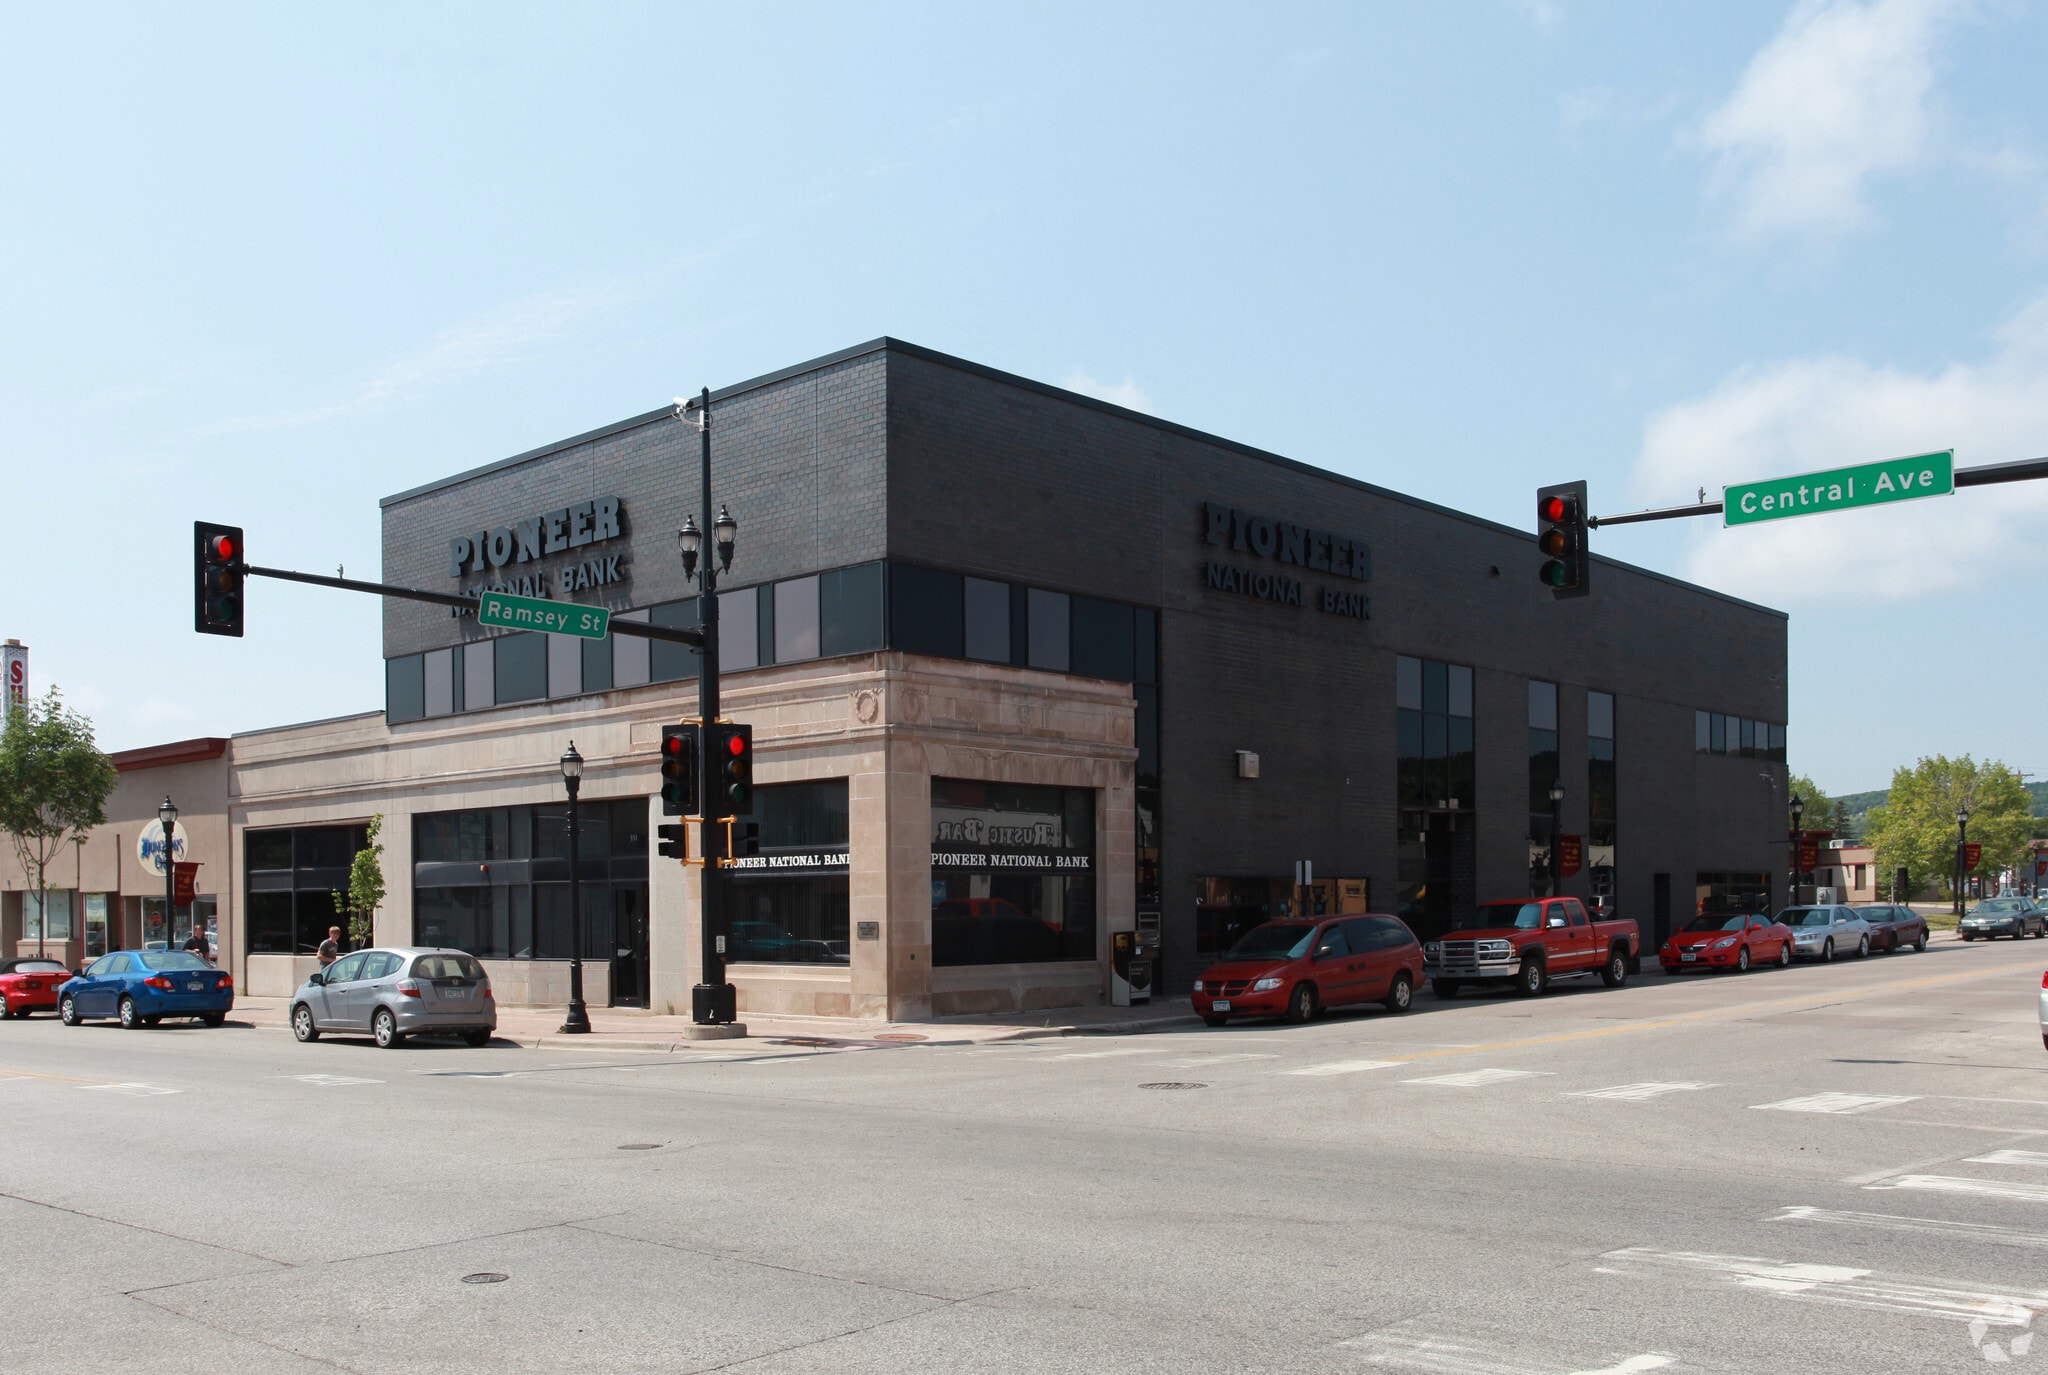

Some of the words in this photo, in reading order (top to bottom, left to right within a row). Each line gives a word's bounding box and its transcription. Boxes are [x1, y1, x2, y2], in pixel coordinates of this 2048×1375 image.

[1740, 477, 1855, 515] Central
[1873, 468, 1936, 494] Ave
[449, 494, 624, 578] PIONEER
[1204, 502, 1372, 582] PIONEER
[561, 555, 624, 593] BANK
[1204, 561, 1307, 607] NATIONAL
[1321, 588, 1371, 619] BANK
[487, 600, 568, 631] Ramsey
[580, 613, 601, 632] St
[769, 854, 821, 867] NATIONAL
[931, 853, 987, 866] PIONEER
[990, 854, 1052, 867] NATIONAL
[1056, 856, 1089, 868] BANK
